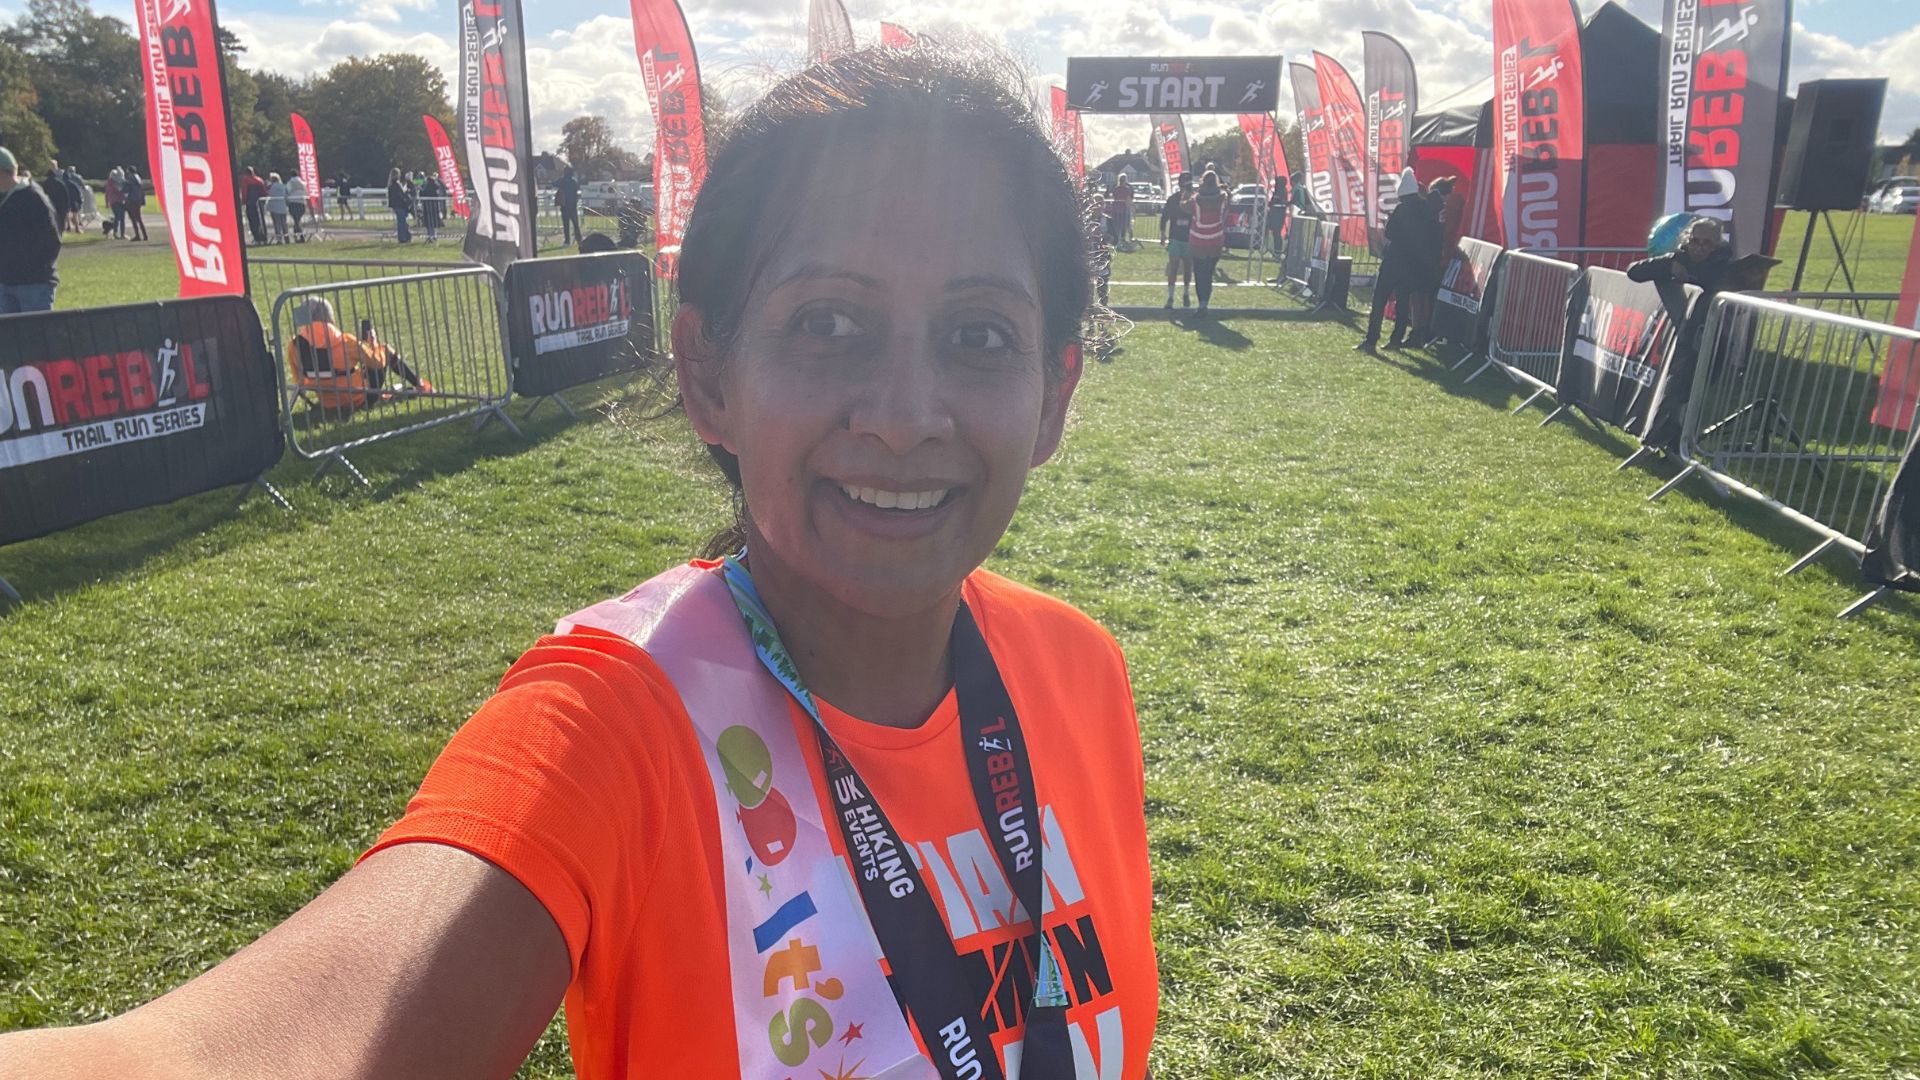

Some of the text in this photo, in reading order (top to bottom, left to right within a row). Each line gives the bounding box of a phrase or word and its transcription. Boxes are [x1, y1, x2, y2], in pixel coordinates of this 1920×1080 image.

[1118, 76, 1226, 108] START
[62, 406, 201, 451] TRAIL RUN SERIES
[834, 774, 915, 900] UK HIKING
[843, 808, 880, 882] EVENTS
